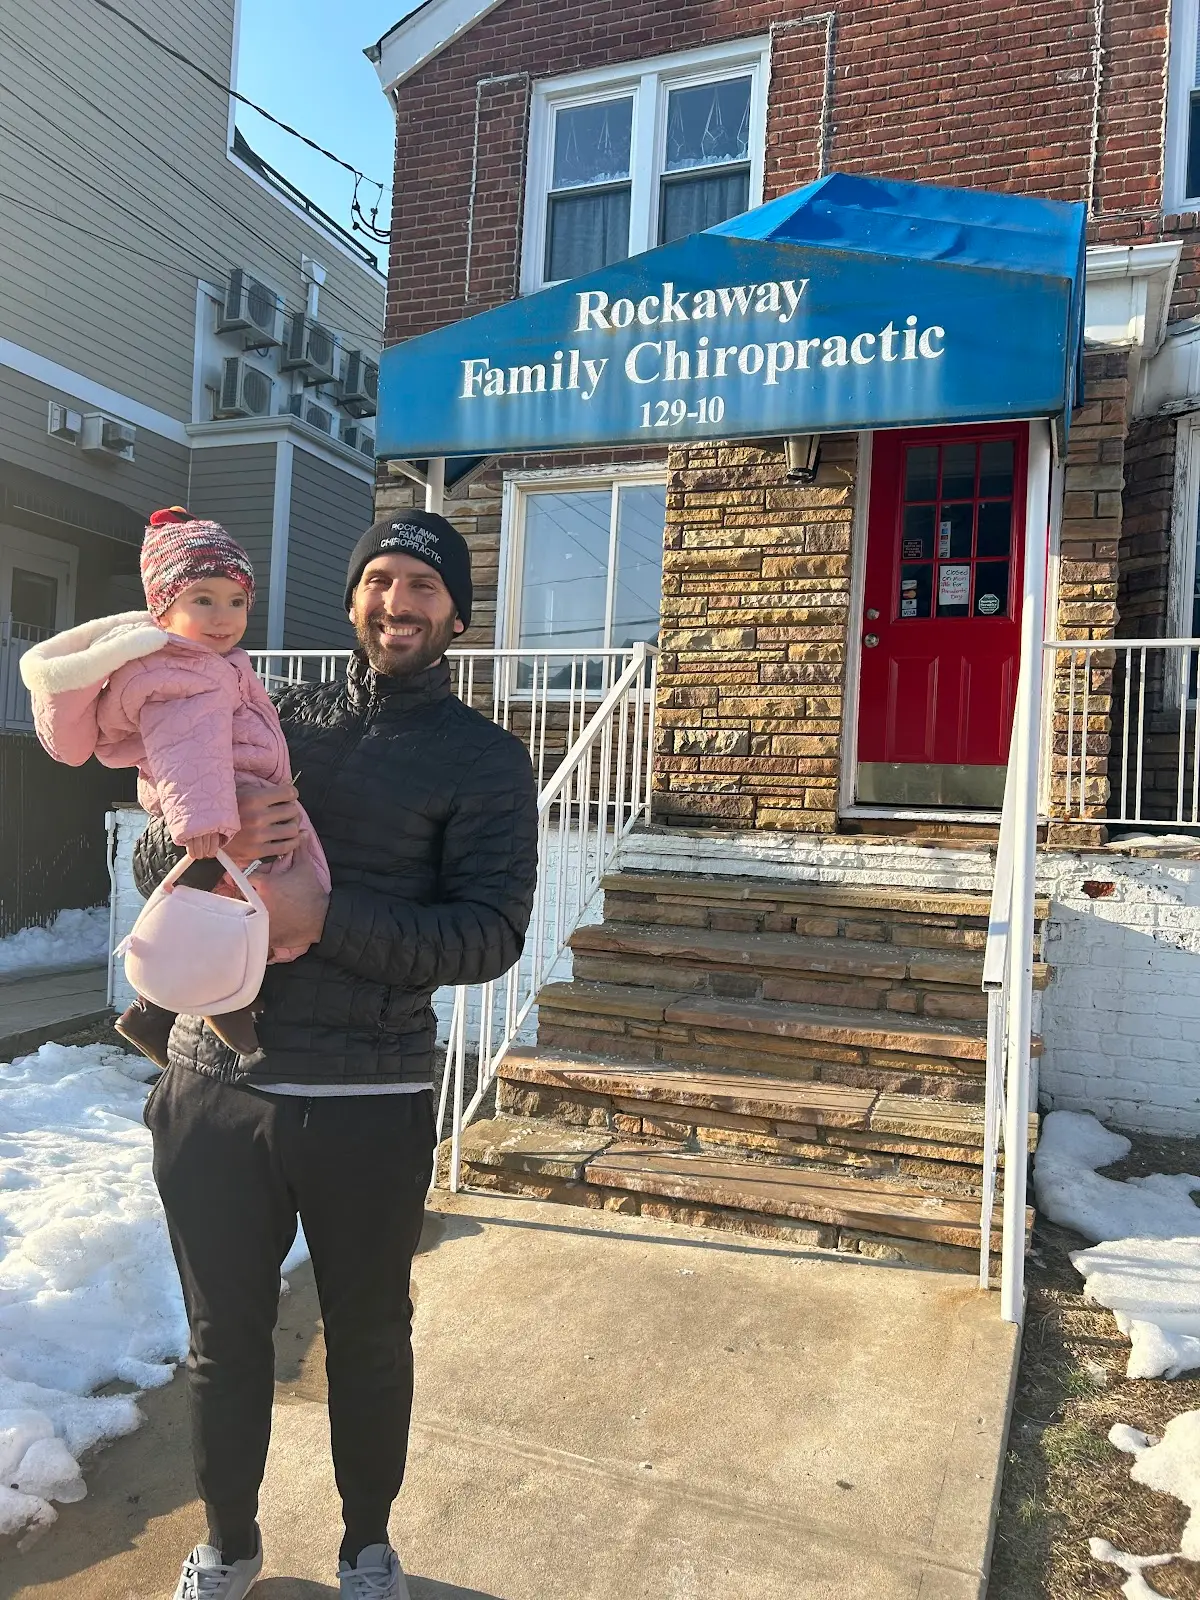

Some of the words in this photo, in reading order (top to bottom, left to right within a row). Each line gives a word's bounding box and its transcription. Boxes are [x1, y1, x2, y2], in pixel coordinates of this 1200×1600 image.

[574, 278, 810, 333] Rockaway
[459, 349, 609, 401] Family
[624, 315, 946, 386] Chiropractic
[640, 396, 725, 428] 129-10
[391, 522, 440, 543] ROCKAWAY
[398, 531, 430, 546] FAMILY
[380, 537, 442, 564] CHIROPRACTIC
